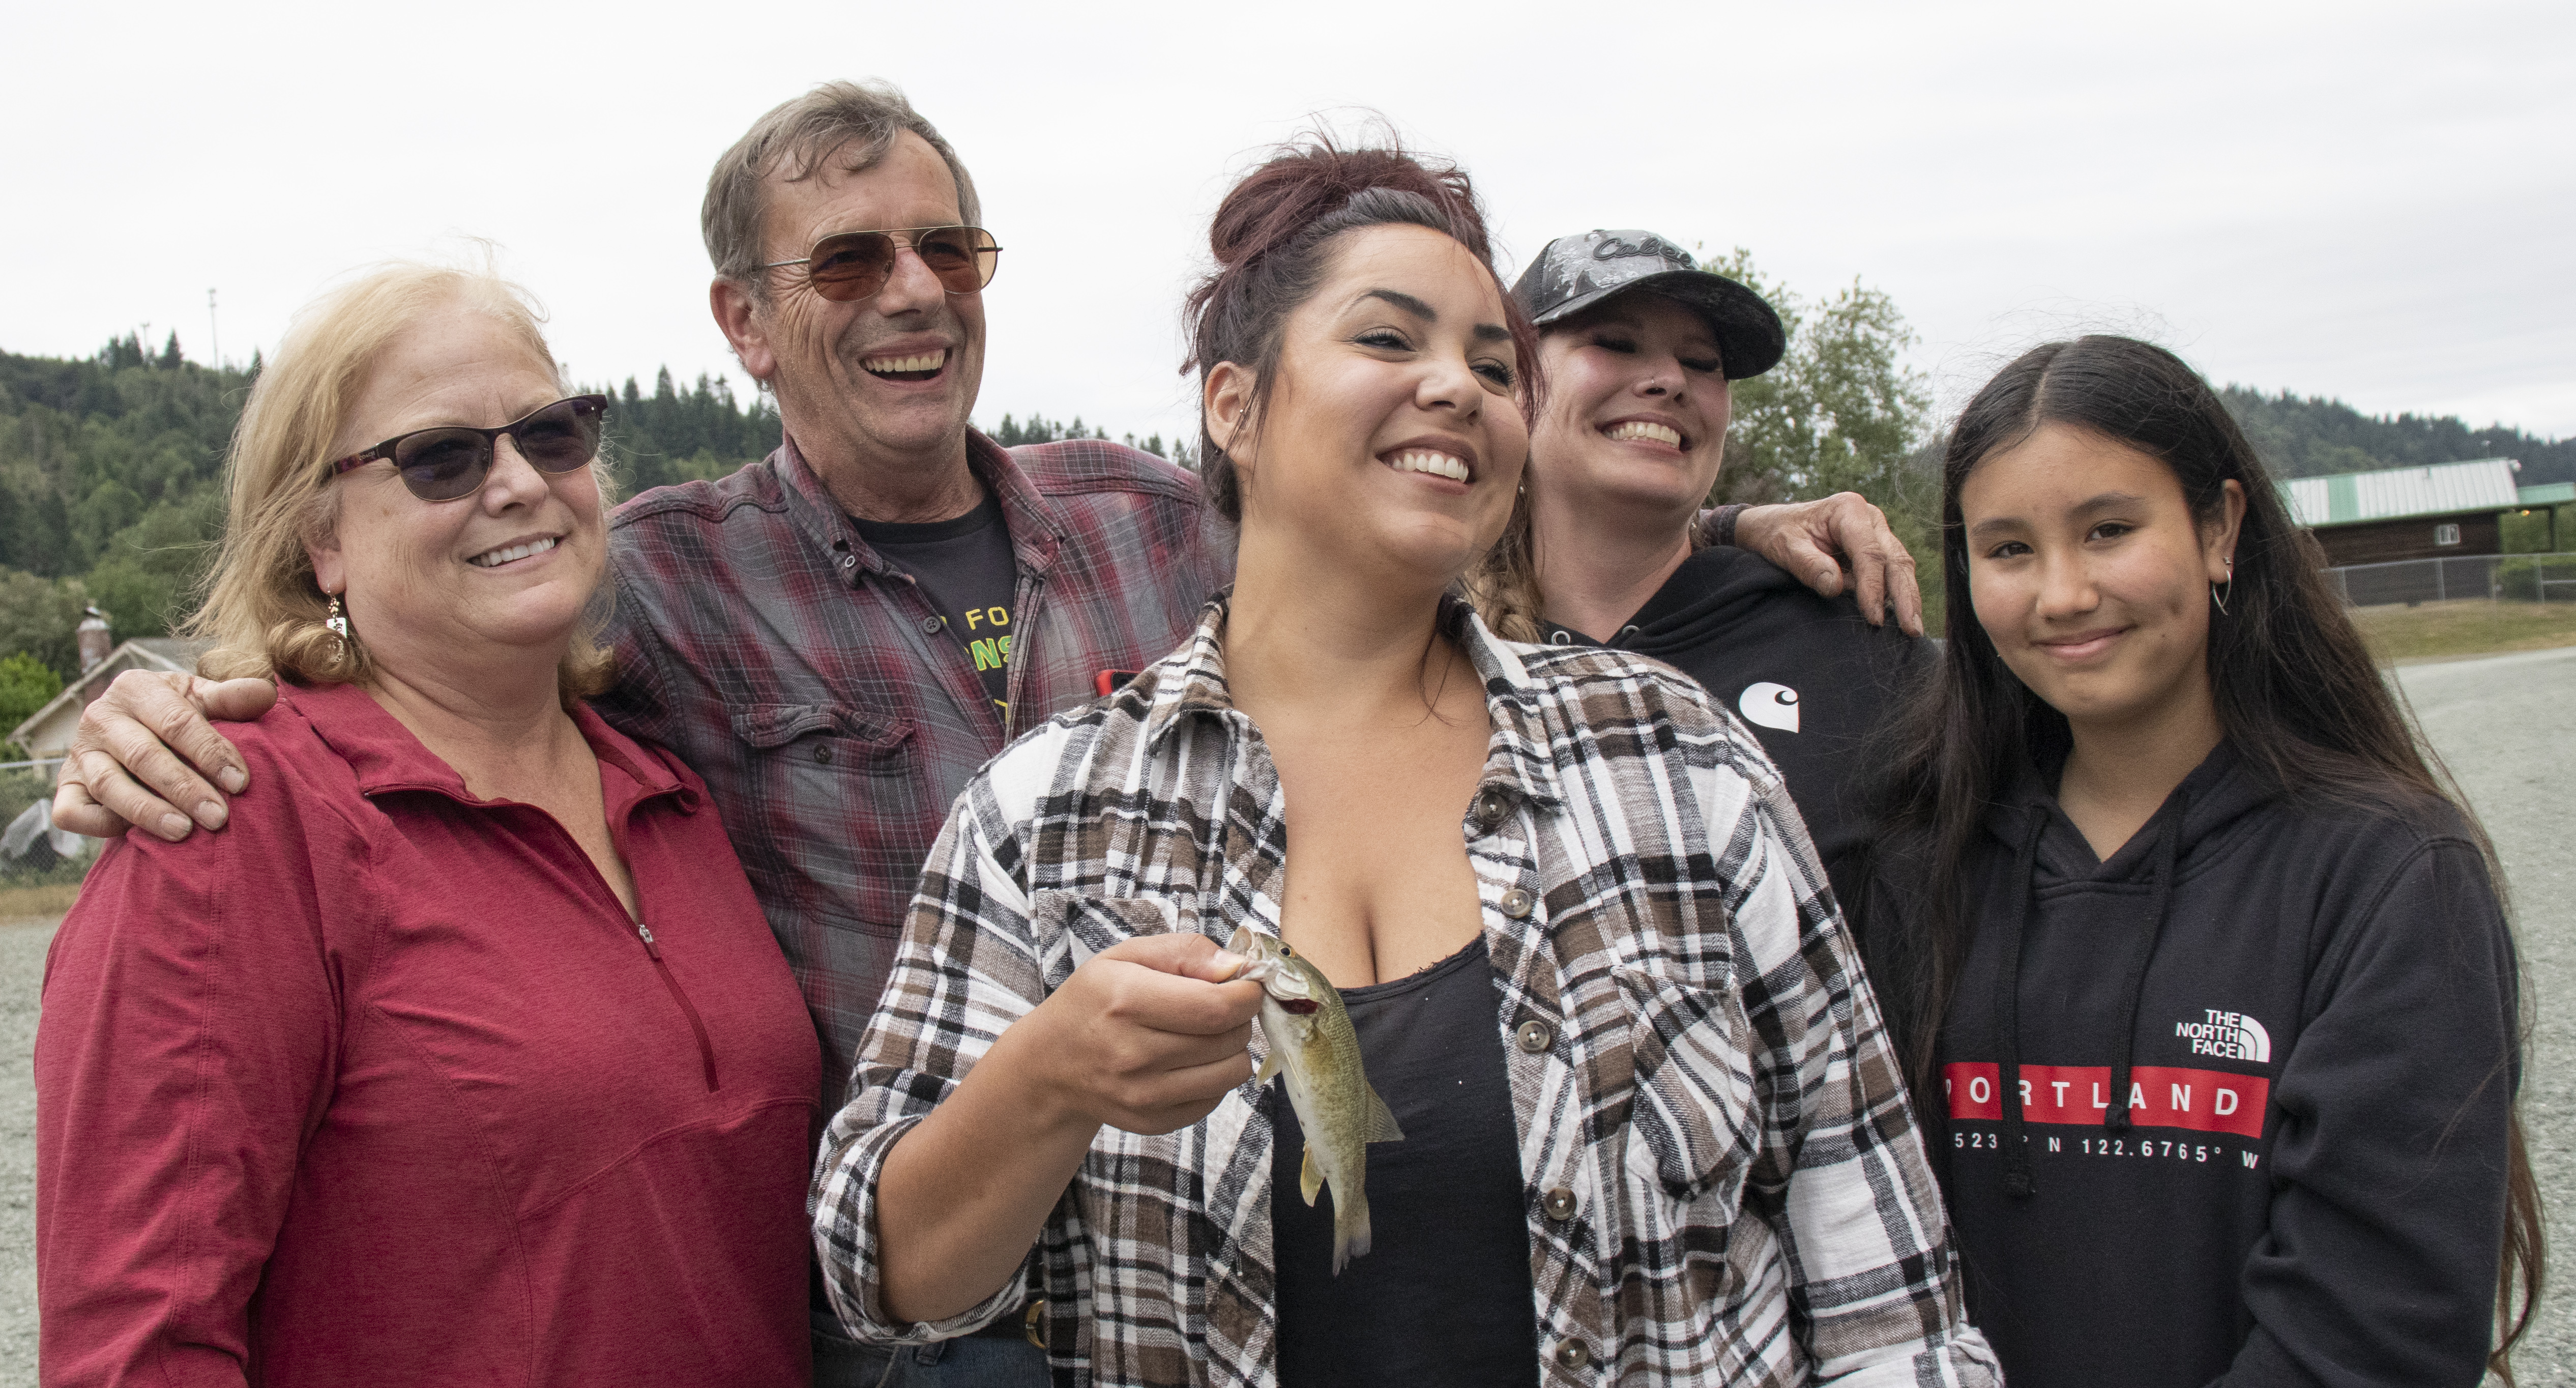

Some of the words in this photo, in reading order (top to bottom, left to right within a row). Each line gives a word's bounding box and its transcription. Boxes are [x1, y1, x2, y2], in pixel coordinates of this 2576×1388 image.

[966, 606, 1009, 630] FO
[970, 635, 1012, 671] NS
[2205, 1009, 2240, 1028] THE
[2176, 1022, 2239, 1043] NORTH
[2192, 1039, 2238, 1059] FACE
[2048, 1137, 2061, 1152] N
[2242, 1150, 2259, 1169] W
